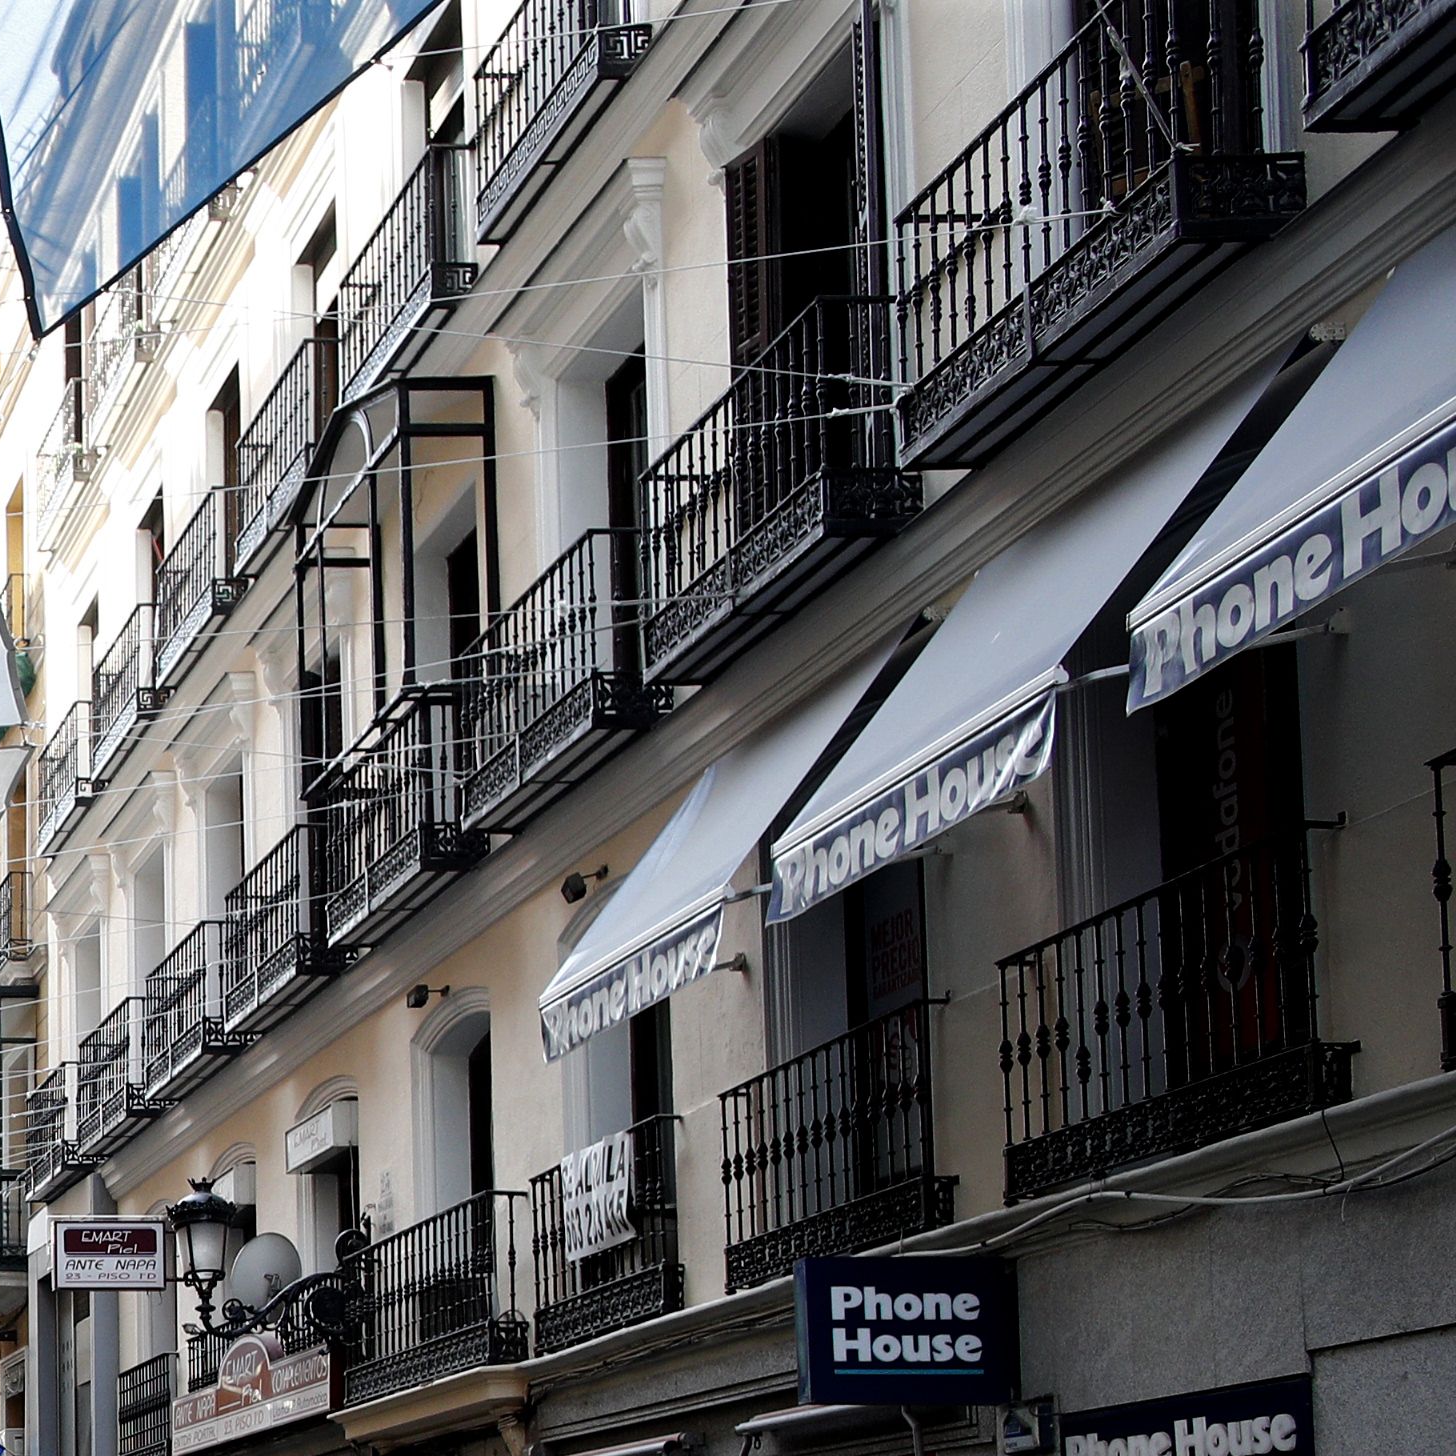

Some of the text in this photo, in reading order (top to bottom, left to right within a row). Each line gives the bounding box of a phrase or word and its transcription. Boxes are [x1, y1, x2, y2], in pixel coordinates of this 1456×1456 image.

[1143, 447, 1456, 698] Phone Ho
[777, 724, 1044, 916] Phone House
[870, 909, 912, 946] MEJOR
[872, 936, 920, 980] PRECIO
[547, 923, 716, 1059] Phone House
[81, 1231, 132, 1244] EMART
[107, 1244, 137, 1254] Piel
[65, 1259, 156, 1270] ANTE NAPA
[65, 1272, 81, 1280] 23
[98, 1272, 130, 1280] PISO
[831, 1286, 980, 1320] Phone
[833, 1327, 982, 1362] House
[225, 1351, 258, 1383] EMART
[272, 1355, 327, 1394] COMPLEMENTOS
[241, 1378, 262, 1406] Piel
[175, 1393, 216, 1428] ANTE NAPA
